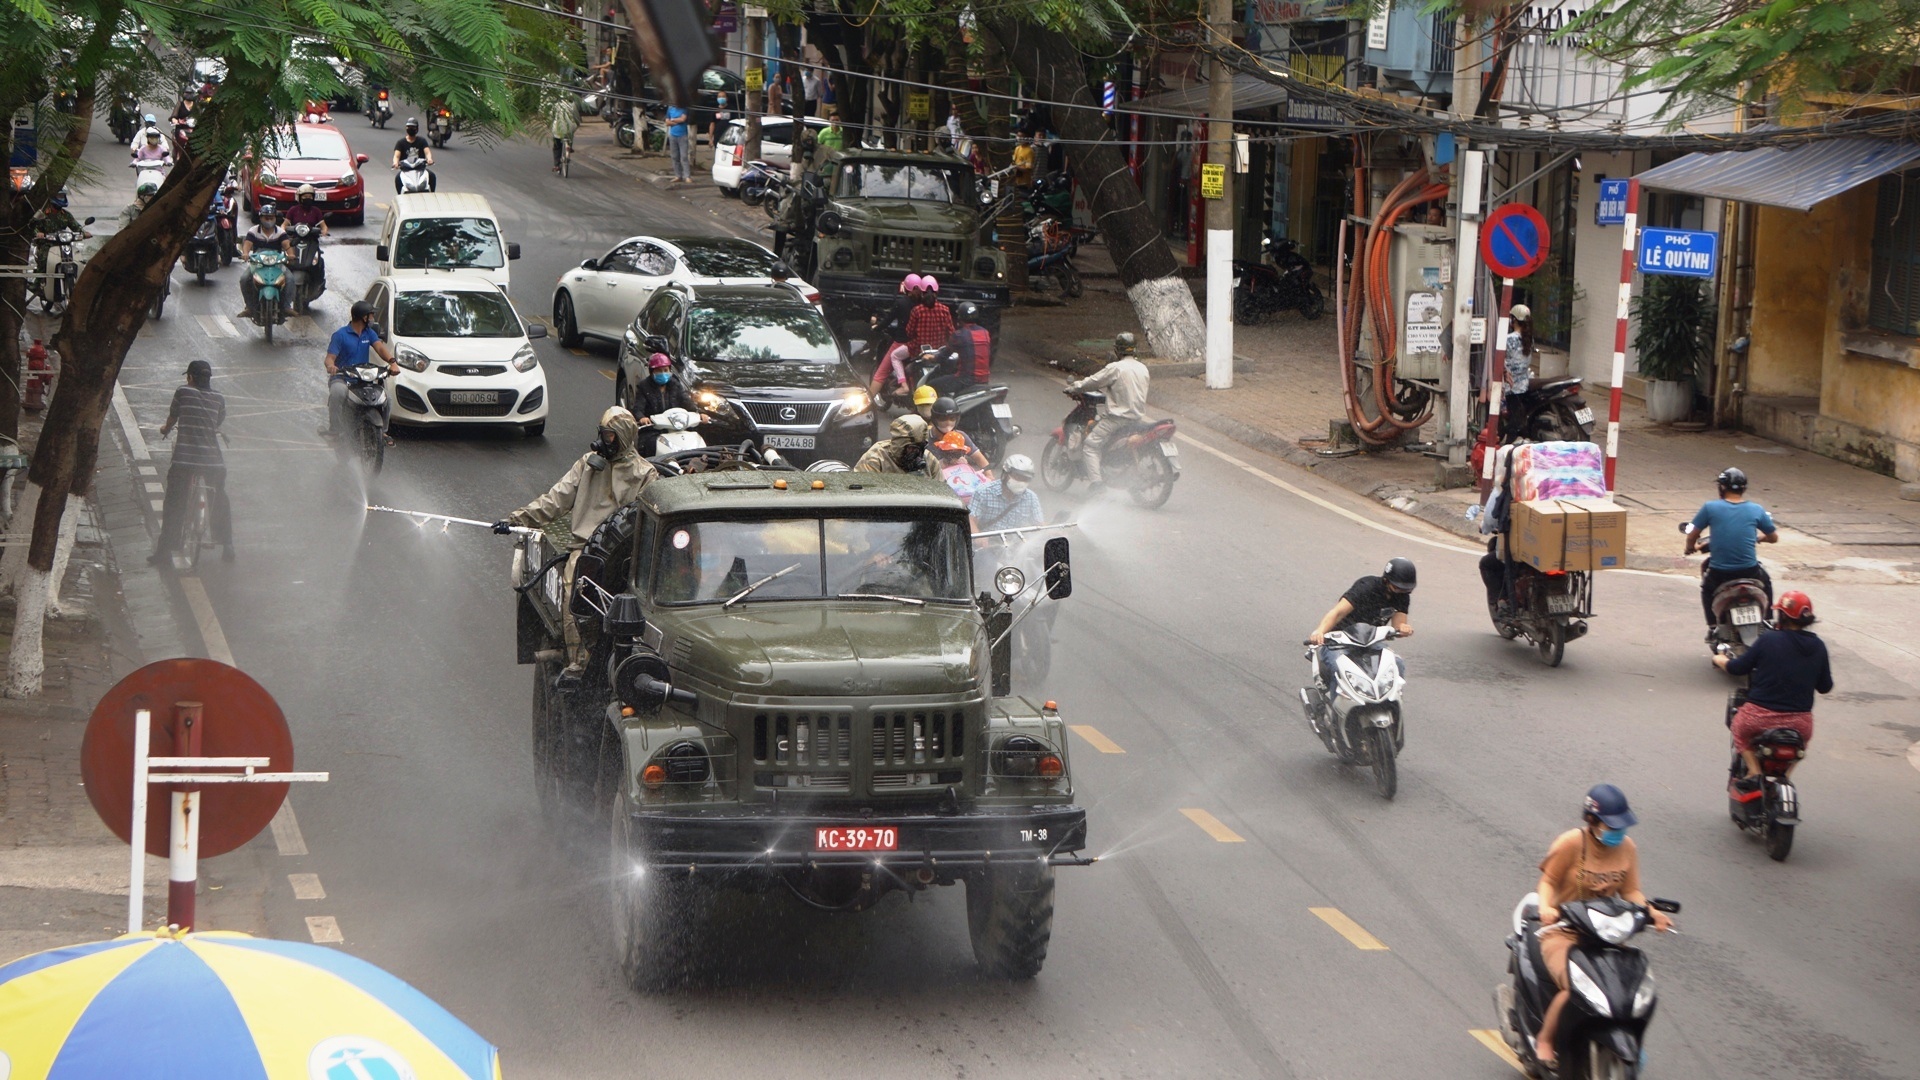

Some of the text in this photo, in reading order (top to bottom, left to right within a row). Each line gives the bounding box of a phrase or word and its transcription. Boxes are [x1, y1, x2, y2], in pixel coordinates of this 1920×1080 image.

[1608, 182, 1620, 195] PHỐ
[1665, 233, 1691, 245] PHỐ
[1645, 245, 1710, 270] LÊ QUÝNH
[818, 829, 895, 848] KC-39-70
[1020, 828, 1048, 842] TM-38
